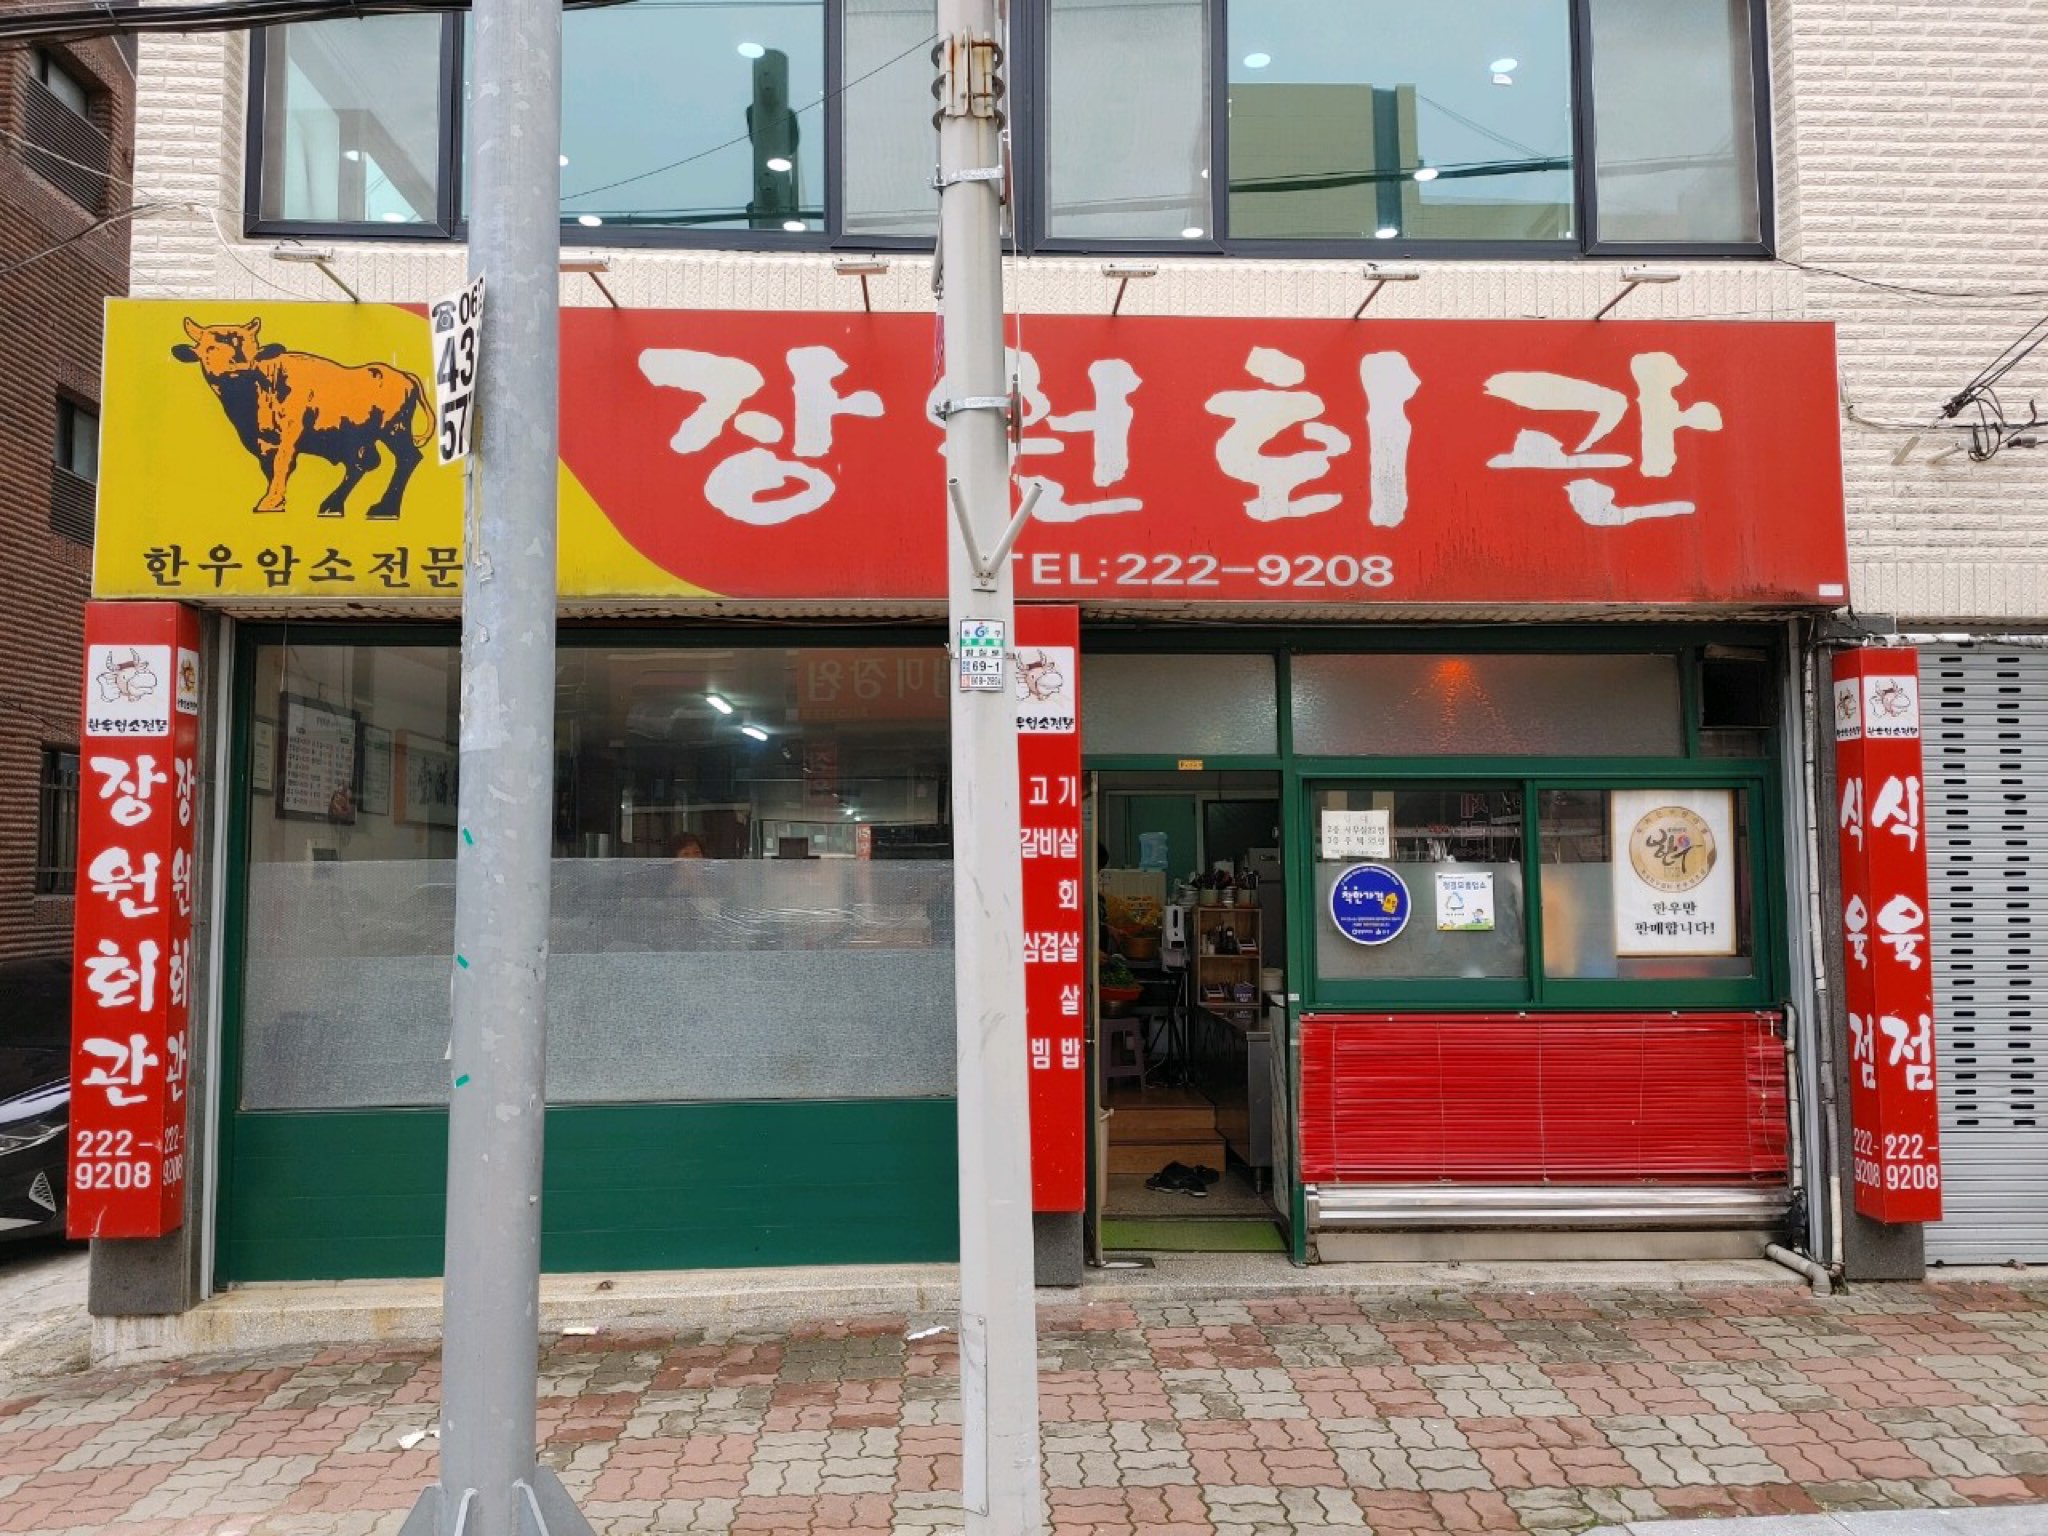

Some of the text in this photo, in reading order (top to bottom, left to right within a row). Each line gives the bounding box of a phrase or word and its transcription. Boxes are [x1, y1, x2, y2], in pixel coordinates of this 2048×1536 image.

[437, 326, 480, 392] 43
[440, 391, 473, 460] 57
[638, 345, 1724, 528] 장원회관
[143, 544, 463, 588] 한우암소전문
[972, 660, 999, 673] 69-1
[1021, 828, 1078, 859] 갈비살
[1652, 901, 1697, 916] 한우만
[81, 755, 168, 1107] 장원회관
[166, 757, 196, 1102] 장원회관
[1634, 921, 1715, 936] 판매합니다!
[1840, 777, 1876, 1090] 식육점
[1871, 775, 1934, 1091] 식육점
[76, 1130, 154, 1157] 222-
[1884, 1133, 1938, 1159] 222-
[75, 1161, 151, 1189] 9208
[1854, 1157, 1881, 1188] 9208
[1886, 1164, 1938, 1190] 9208
